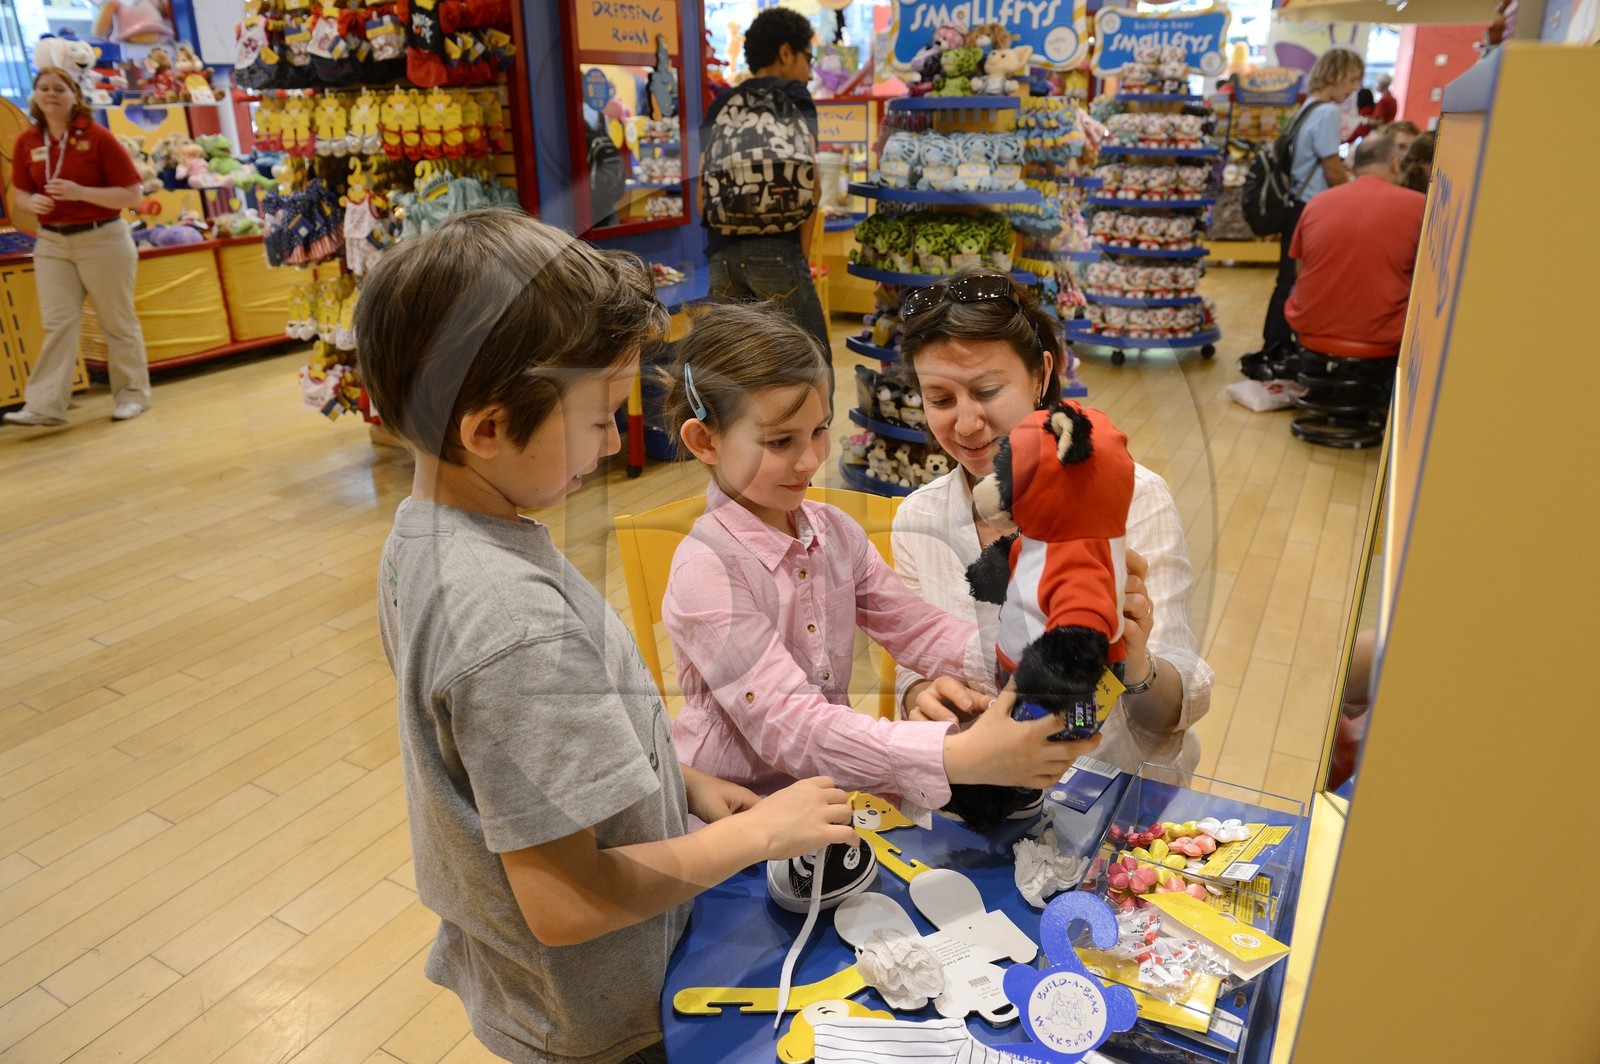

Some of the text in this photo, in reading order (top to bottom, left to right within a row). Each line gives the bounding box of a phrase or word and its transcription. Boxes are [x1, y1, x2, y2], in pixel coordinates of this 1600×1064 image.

[592, 1, 663, 23] DRESSING
[612, 27, 648, 44] ROOM
[1037, 979, 1098, 1015] BUILD-A-BEAR
[1034, 1016, 1096, 1047] WORKSHOP
